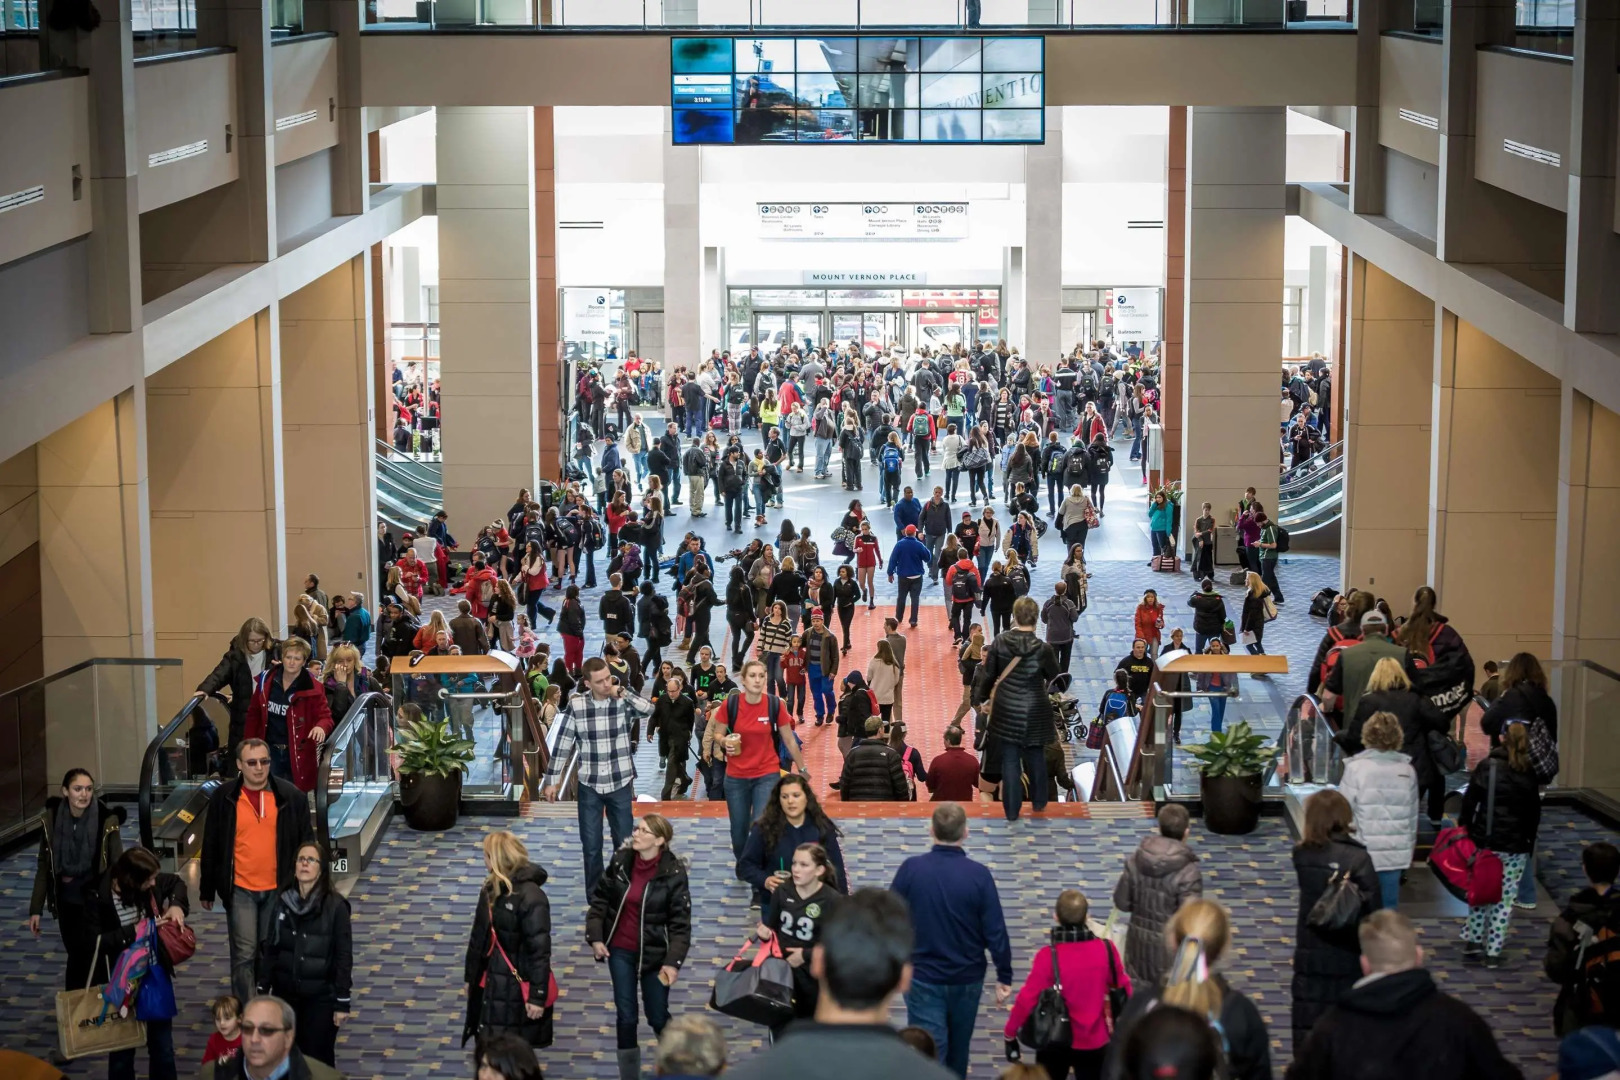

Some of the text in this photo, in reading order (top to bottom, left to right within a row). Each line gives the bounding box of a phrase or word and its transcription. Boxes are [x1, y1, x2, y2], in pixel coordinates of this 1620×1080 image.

[700, 675, 709, 687] 12
[333, 860, 347, 871] 26
[780, 910, 814, 941] 23
